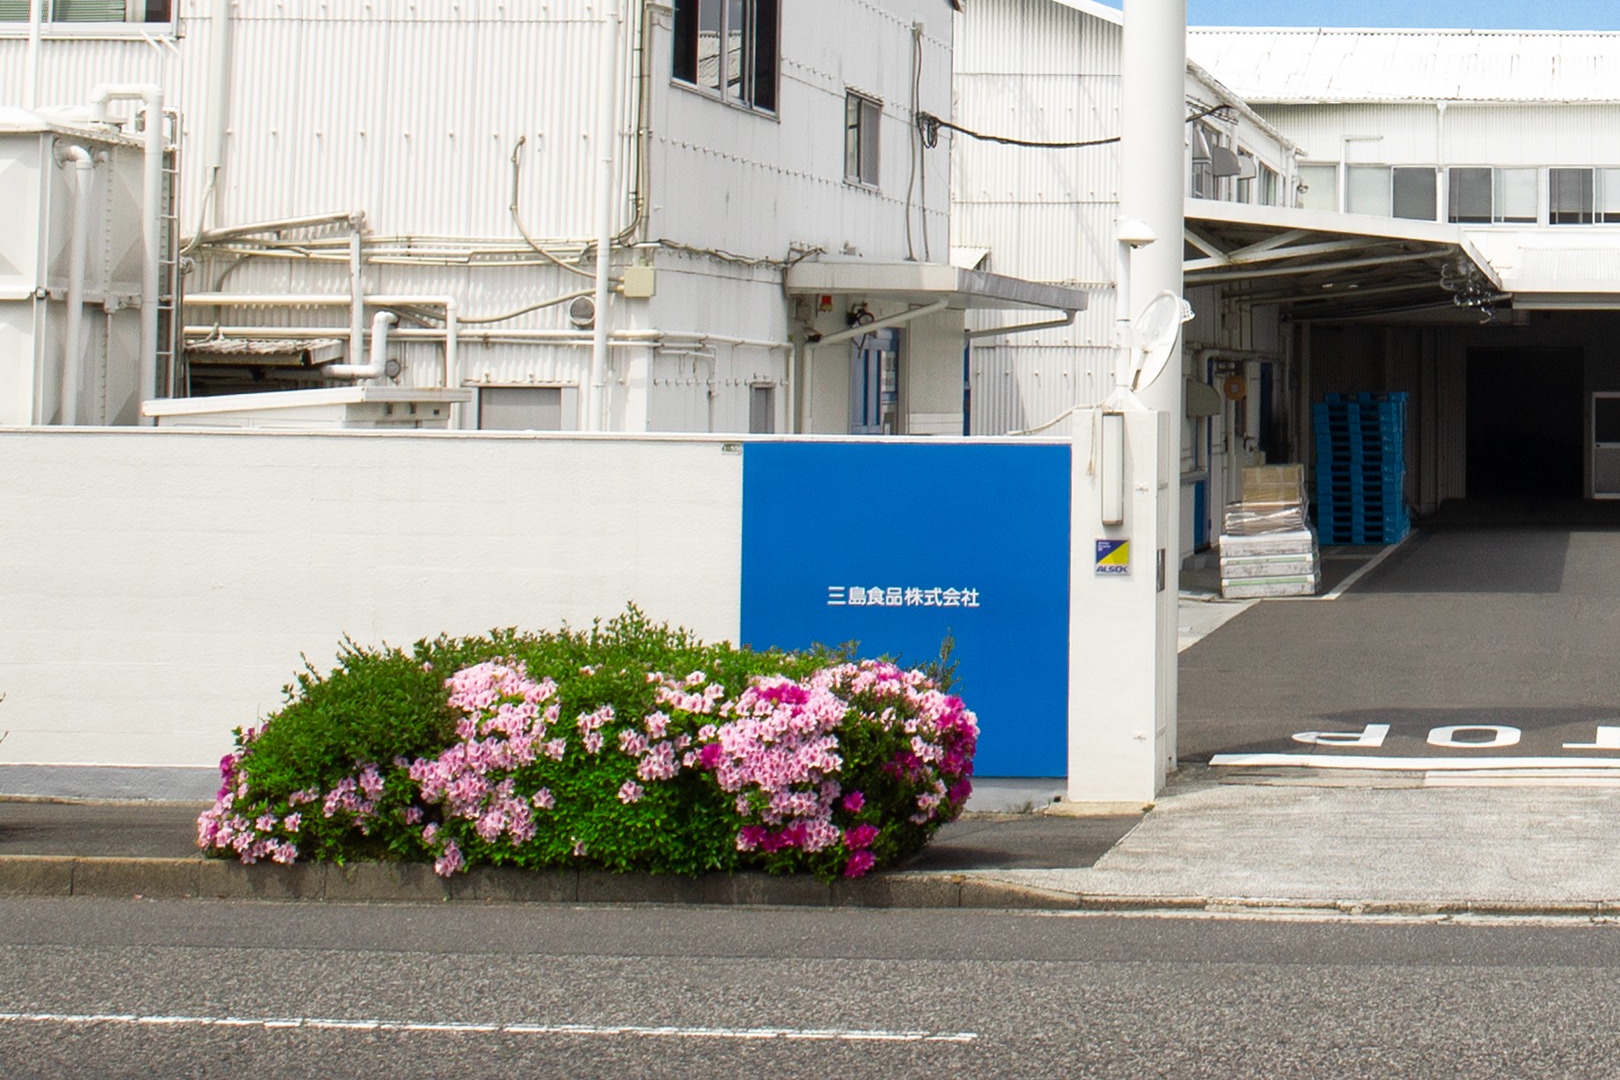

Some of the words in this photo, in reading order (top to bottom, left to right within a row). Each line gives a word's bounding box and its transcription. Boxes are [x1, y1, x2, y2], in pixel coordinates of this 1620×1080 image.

[1096, 565, 1128, 574] ALSOK
[826, 585, 981, 609] 三島食品株式会社
